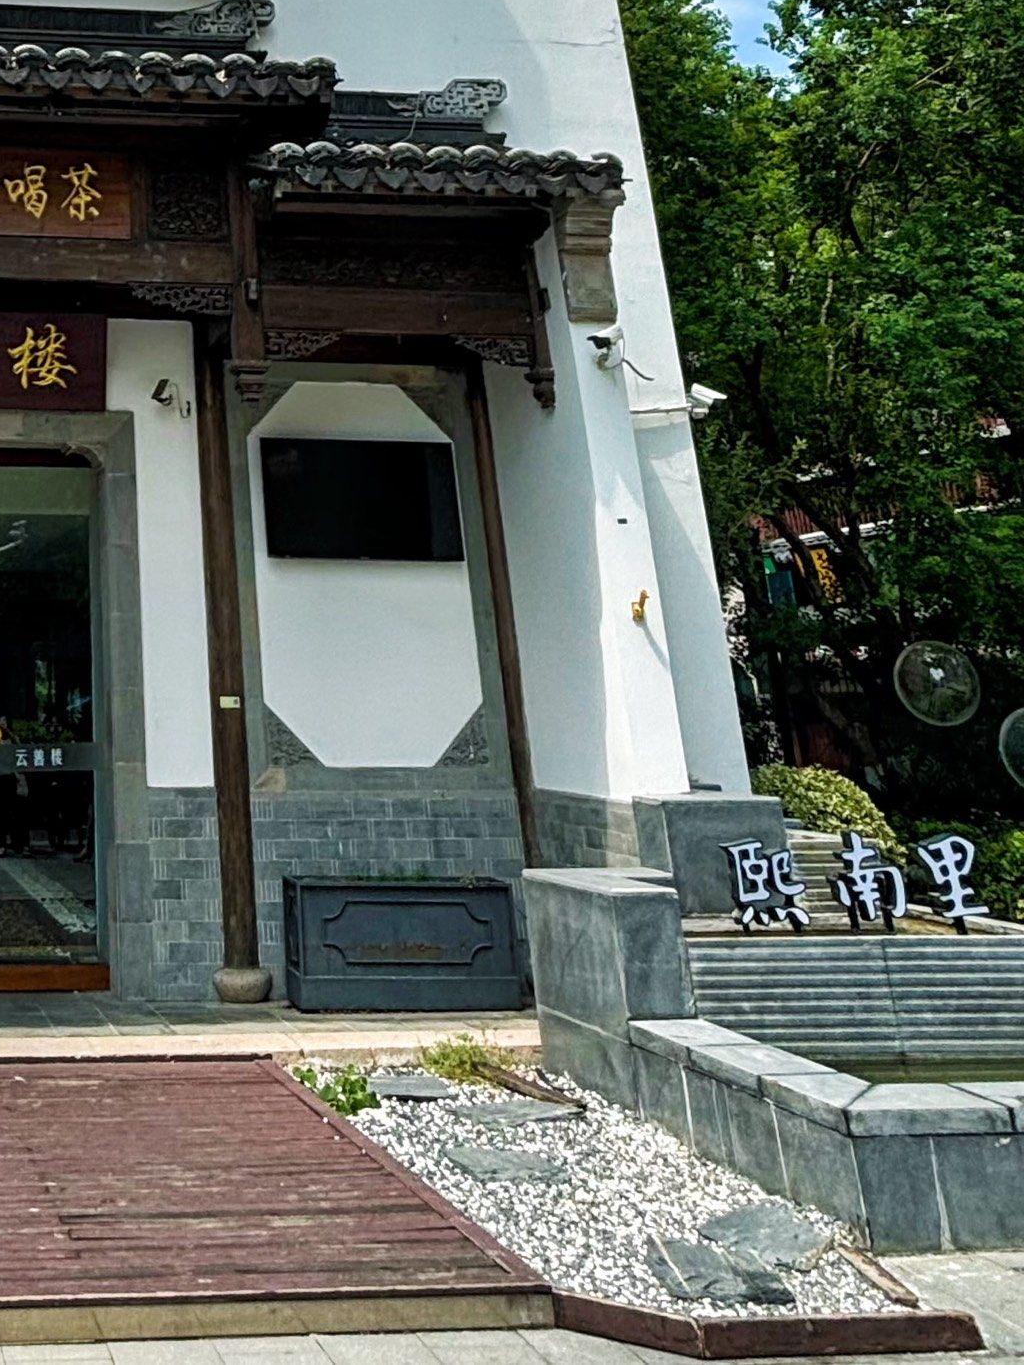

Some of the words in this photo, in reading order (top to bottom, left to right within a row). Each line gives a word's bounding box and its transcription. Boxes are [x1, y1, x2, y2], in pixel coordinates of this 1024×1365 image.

[15, 747, 64, 767] 云善楼
[723, 831, 991, 926] 熙南里
